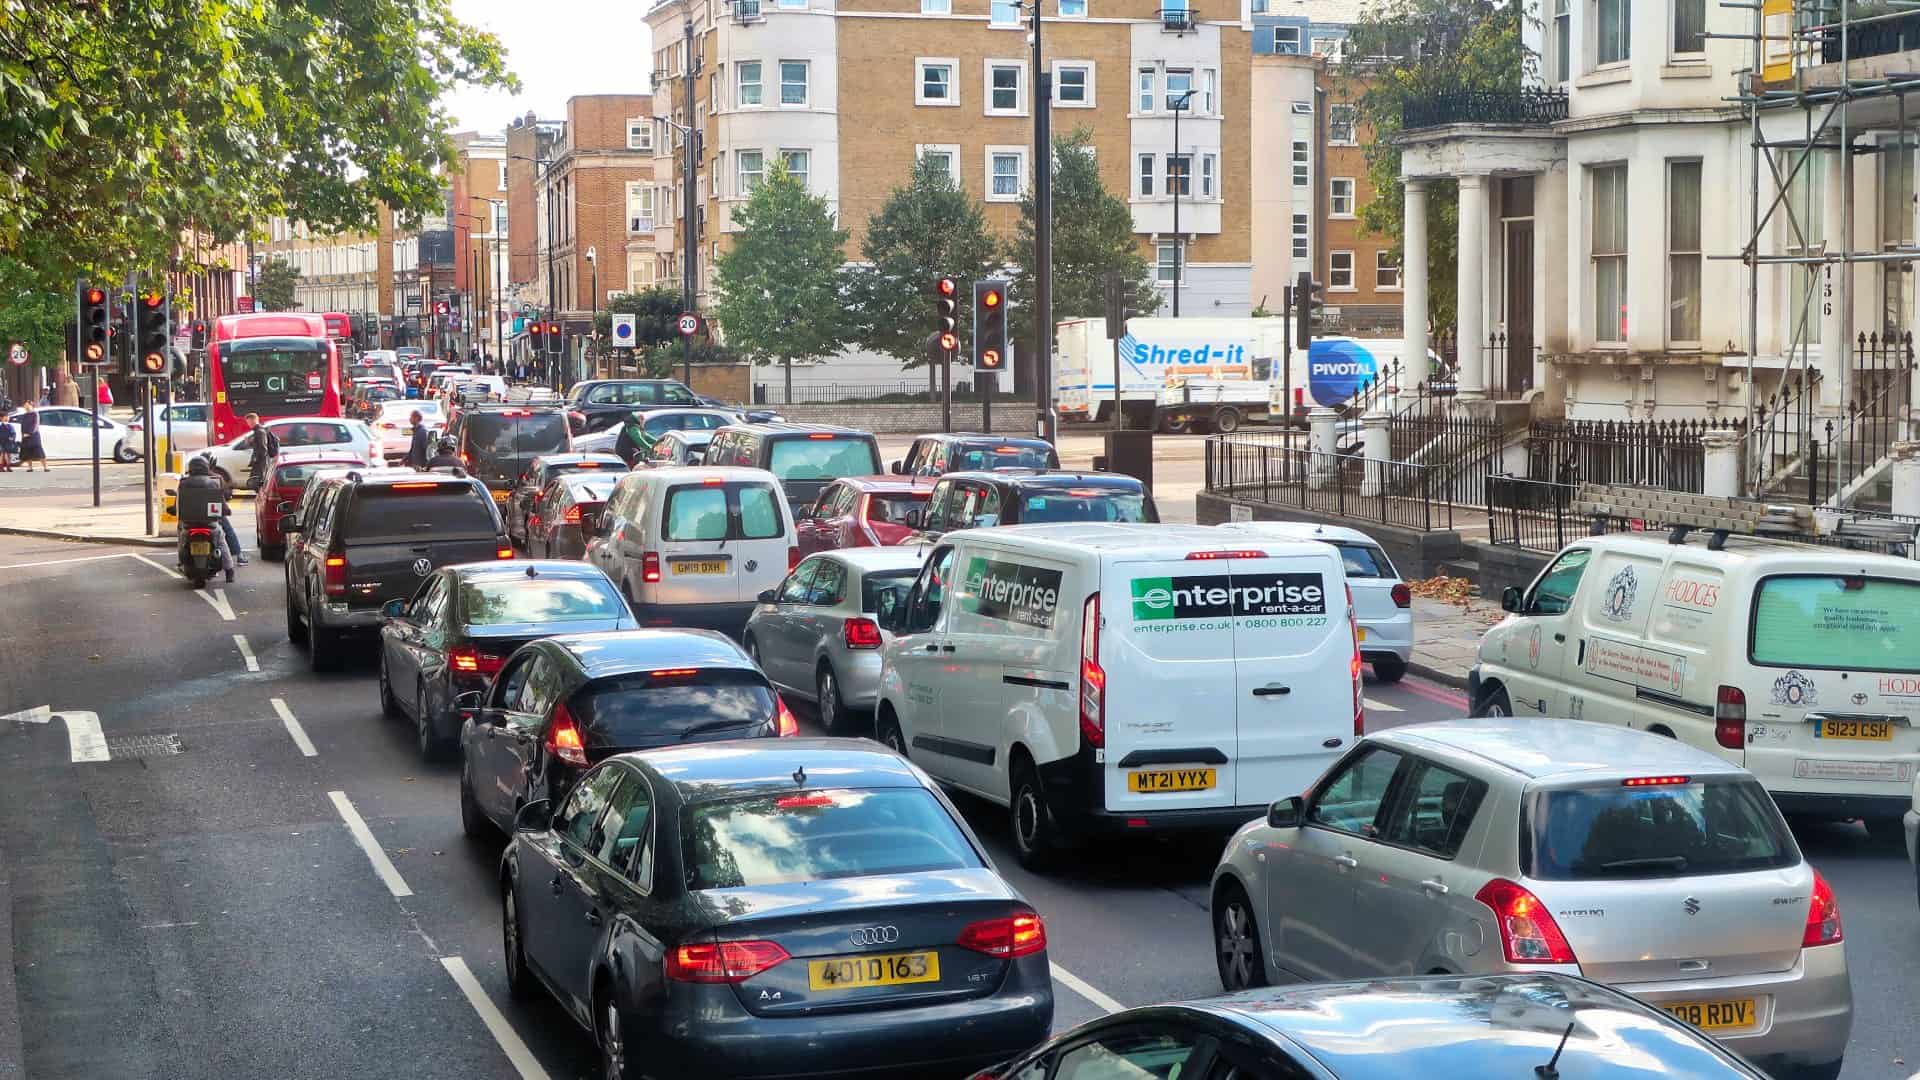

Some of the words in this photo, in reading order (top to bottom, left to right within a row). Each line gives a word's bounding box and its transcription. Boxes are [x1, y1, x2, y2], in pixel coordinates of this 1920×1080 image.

[1824, 265, 1832, 316] 136
[680, 319, 696, 329] 20
[13, 350, 27, 359] 20
[1133, 343, 1244, 364] Shred-it
[1312, 363, 1374, 376] PIVOTAL
[210, 503, 218, 513] L
[967, 573, 1056, 615] enterprise
[1143, 580, 1322, 610] enterprise
[1666, 579, 1719, 607] HODGES
[1261, 603, 1322, 614] rent-a-car
[1017, 610, 1051, 626] rent-a-car
[1134, 621, 1231, 634] enterprise.co.uk
[1245, 618, 1277, 628] 0800
[1280, 617, 1303, 628] 800
[1306, 617, 1327, 626] 227
[1879, 678, 1920, 694] HOD
[1827, 722, 1857, 737] S123
[1861, 723, 1888, 738] CSH
[1138, 772, 1173, 788] MT21
[1178, 771, 1207, 785] YYX
[759, 989, 782, 1001] A4
[1664, 1005, 1701, 1026] 08
[1708, 1002, 1746, 1025] RDV
